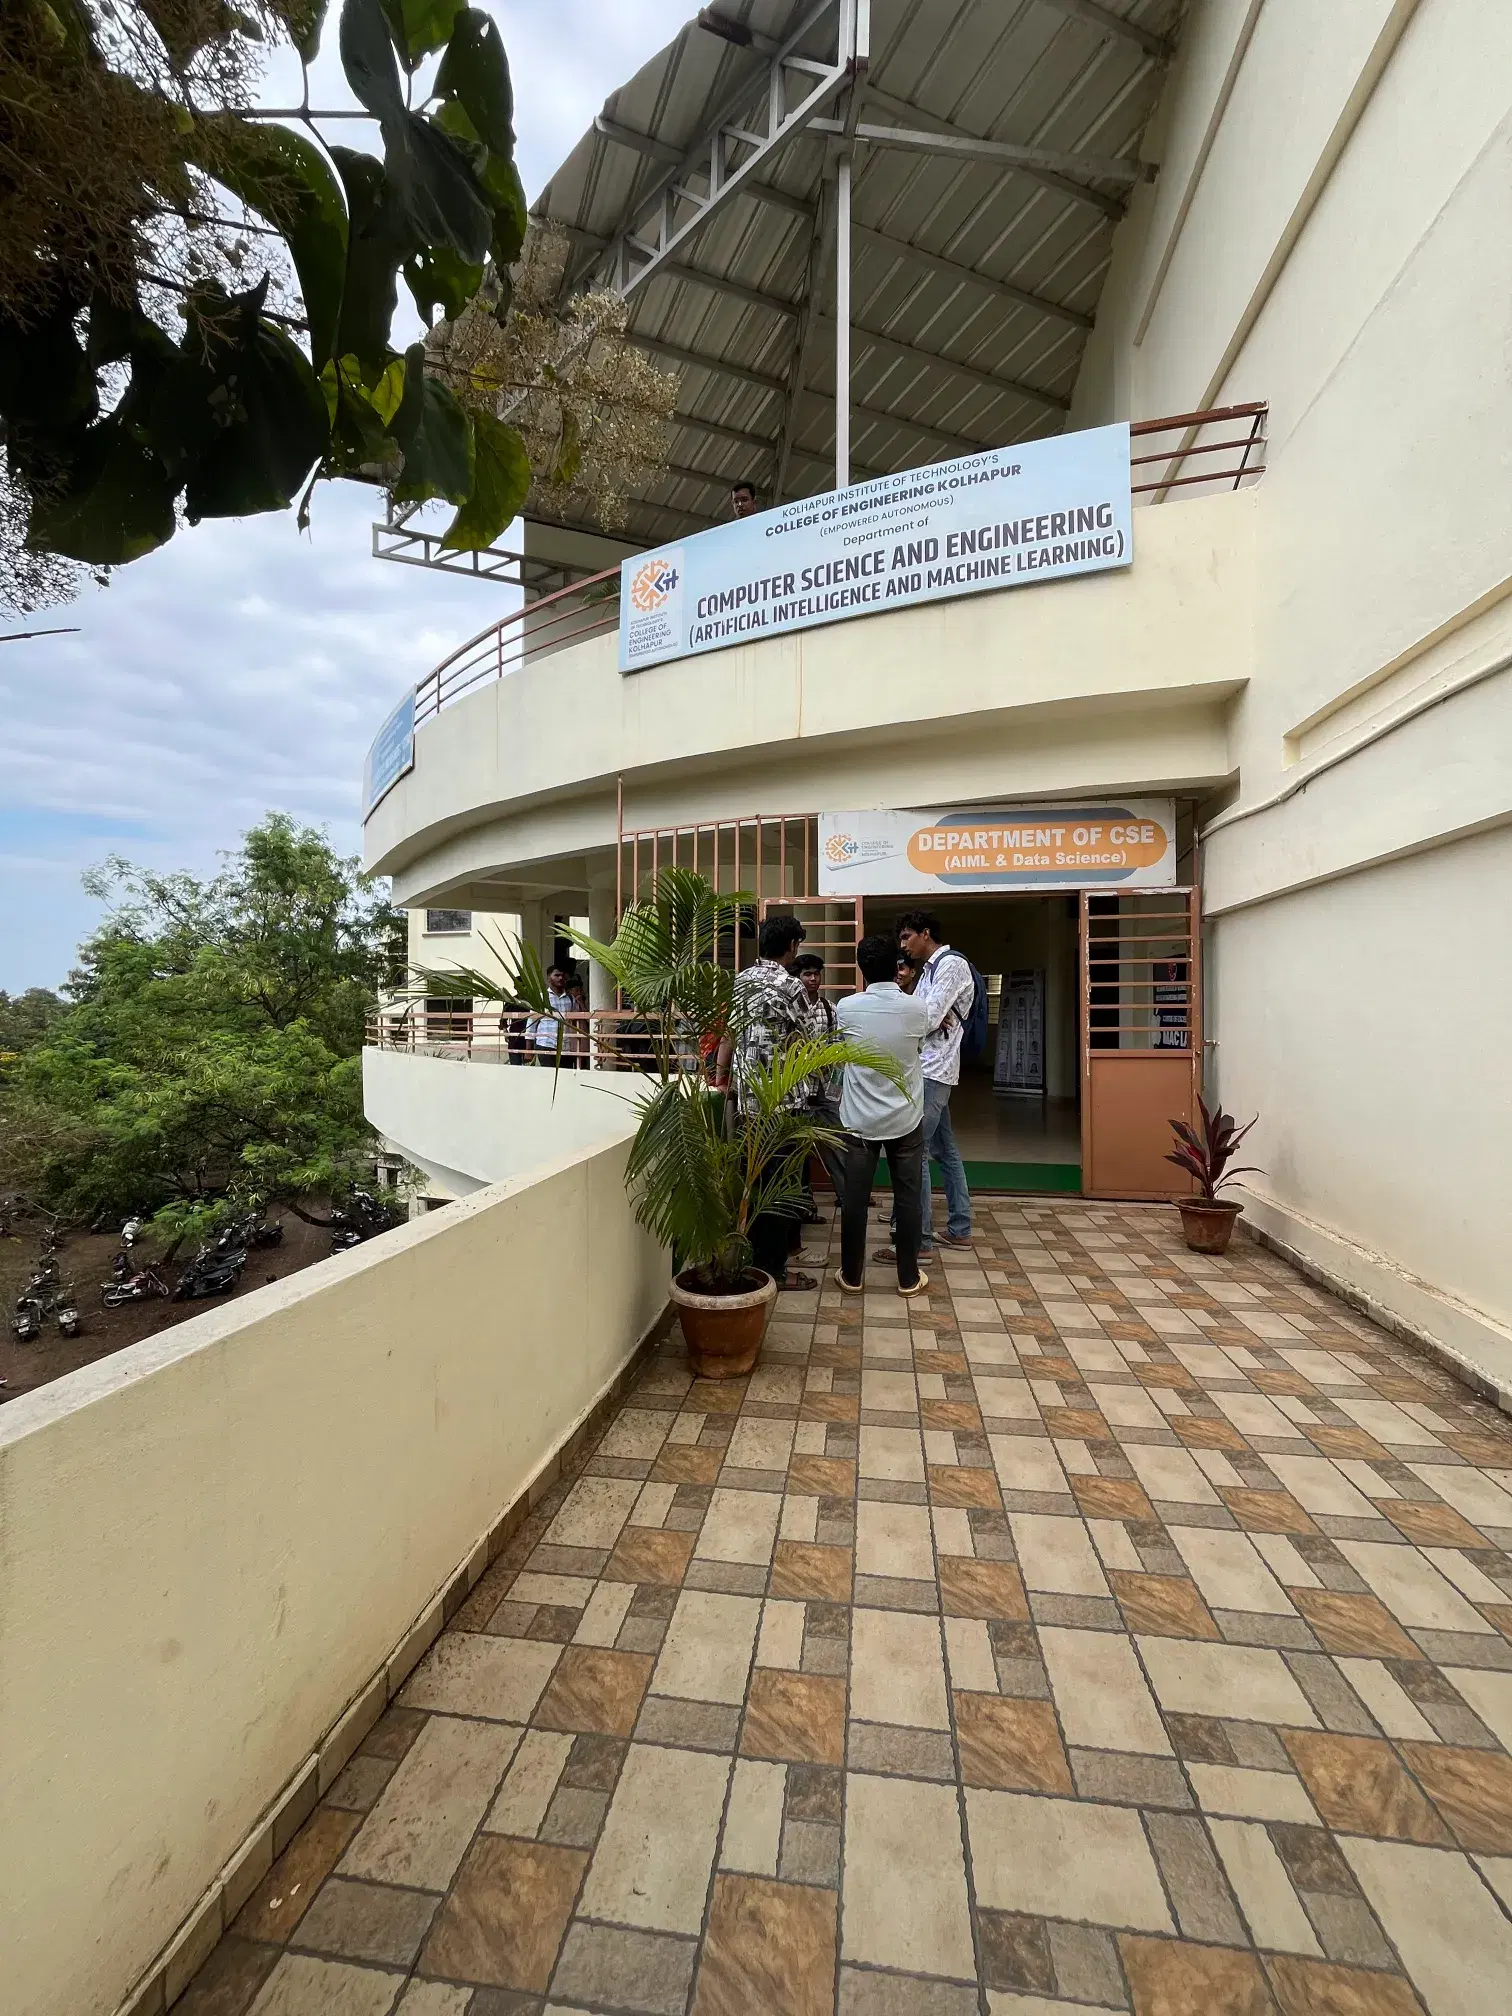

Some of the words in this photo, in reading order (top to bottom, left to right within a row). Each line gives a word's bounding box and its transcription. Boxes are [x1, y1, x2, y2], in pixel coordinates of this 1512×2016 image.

[765, 513, 820, 537] COLLEGE
[821, 508, 839, 521] OF
[841, 483, 935, 516] ENGINEERING
[938, 464, 1021, 492] KOLHAPUR
[782, 496, 835, 518] KOLHAPUR
[837, 480, 890, 502] INSTITUTE
[892, 476, 907, 487] OF
[910, 454, 999, 483] TECHNOLOGY'S
[820, 514, 879, 537] (EMPOWERED
[881, 495, 954, 520] AUTONOMOUS)
[843, 521, 914, 546] Department
[917, 516, 929, 528] of
[697, 572, 795, 619] COMPUTER
[801, 549, 885, 592] SCIENCE
[891, 537, 939, 570] AND
[946, 502, 1112, 558] ENGINEERING
[689, 608, 769, 648] (ARTIFICIAL
[773, 581, 881, 623] INTELLIGENCE
[885, 572, 922, 597] AND
[927, 555, 1011, 588] MACHINE
[1017, 530, 1124, 572] LEARNING)
[629, 626, 656, 639] COLLEGE
[658, 623, 667, 631] OF
[629, 629, 671, 646] ENGINEERING
[628, 640, 663, 654] KOLHAPUR
[918, 828, 1066, 851] DEPARTMENT
[1072, 826, 1103, 846] OF
[1109, 825, 1155, 845] CSE
[944, 854, 989, 871] (AIML
[995, 854, 1007, 867] &
[1013, 853, 1051, 867] Data
[1055, 850, 1127, 866] Science)
